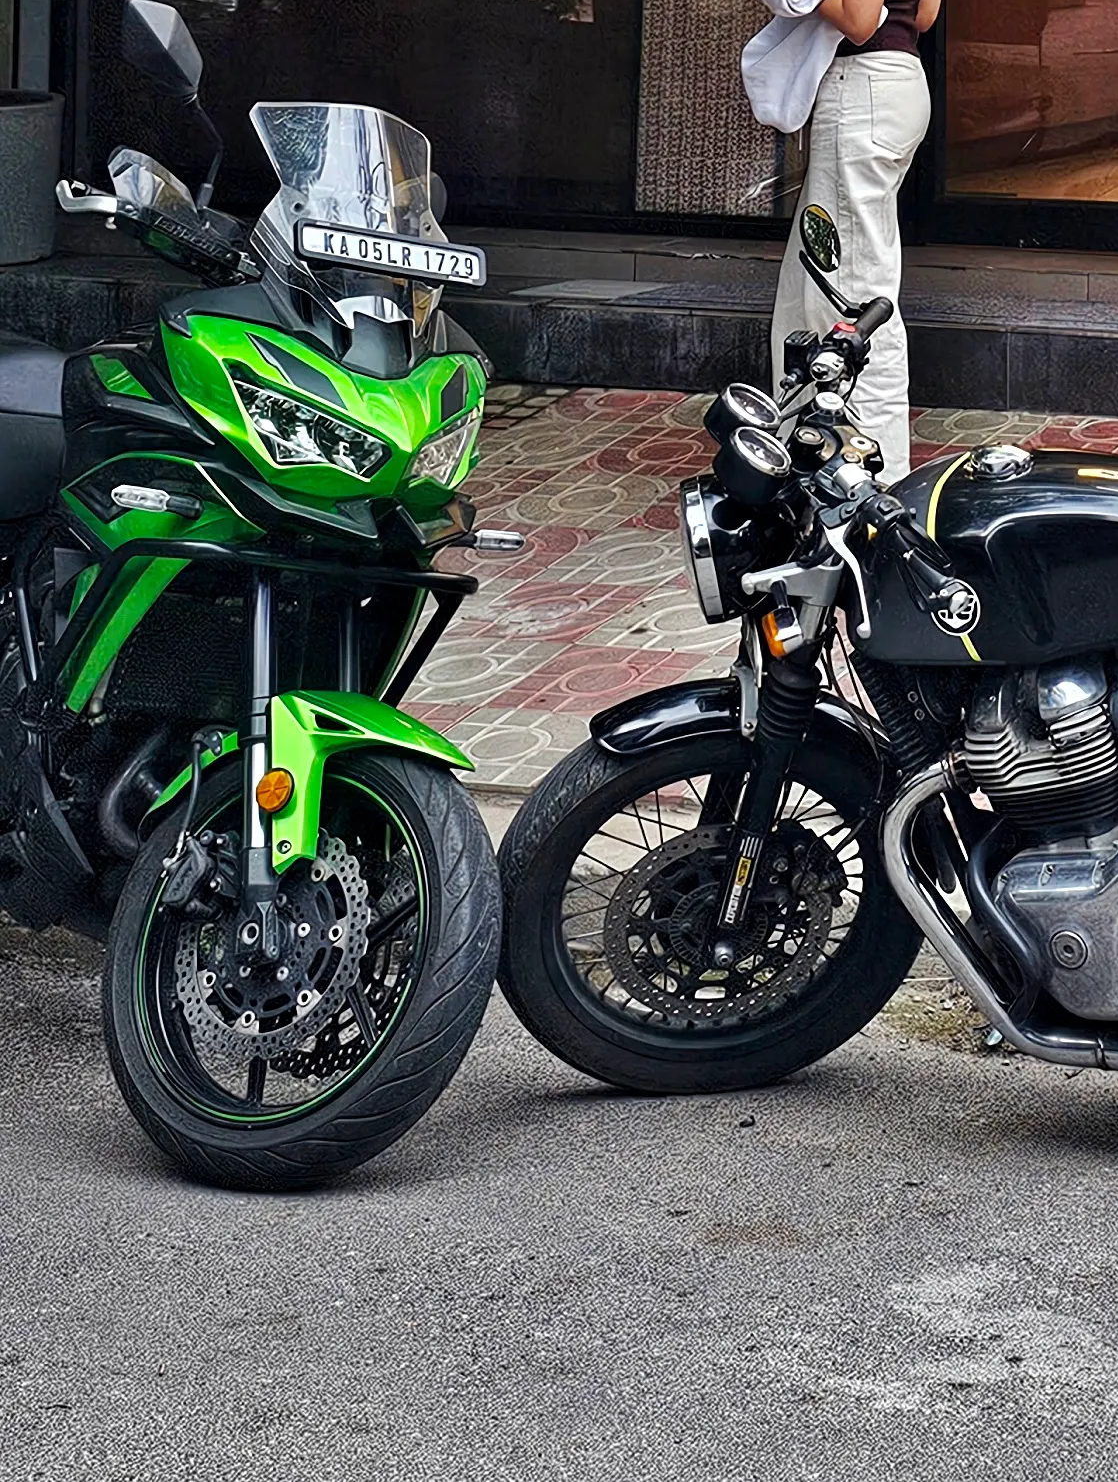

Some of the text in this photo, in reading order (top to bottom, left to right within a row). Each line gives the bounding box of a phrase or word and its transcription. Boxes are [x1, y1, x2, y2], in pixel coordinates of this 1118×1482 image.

[323, 232, 474, 277] KA 05LR 1729
